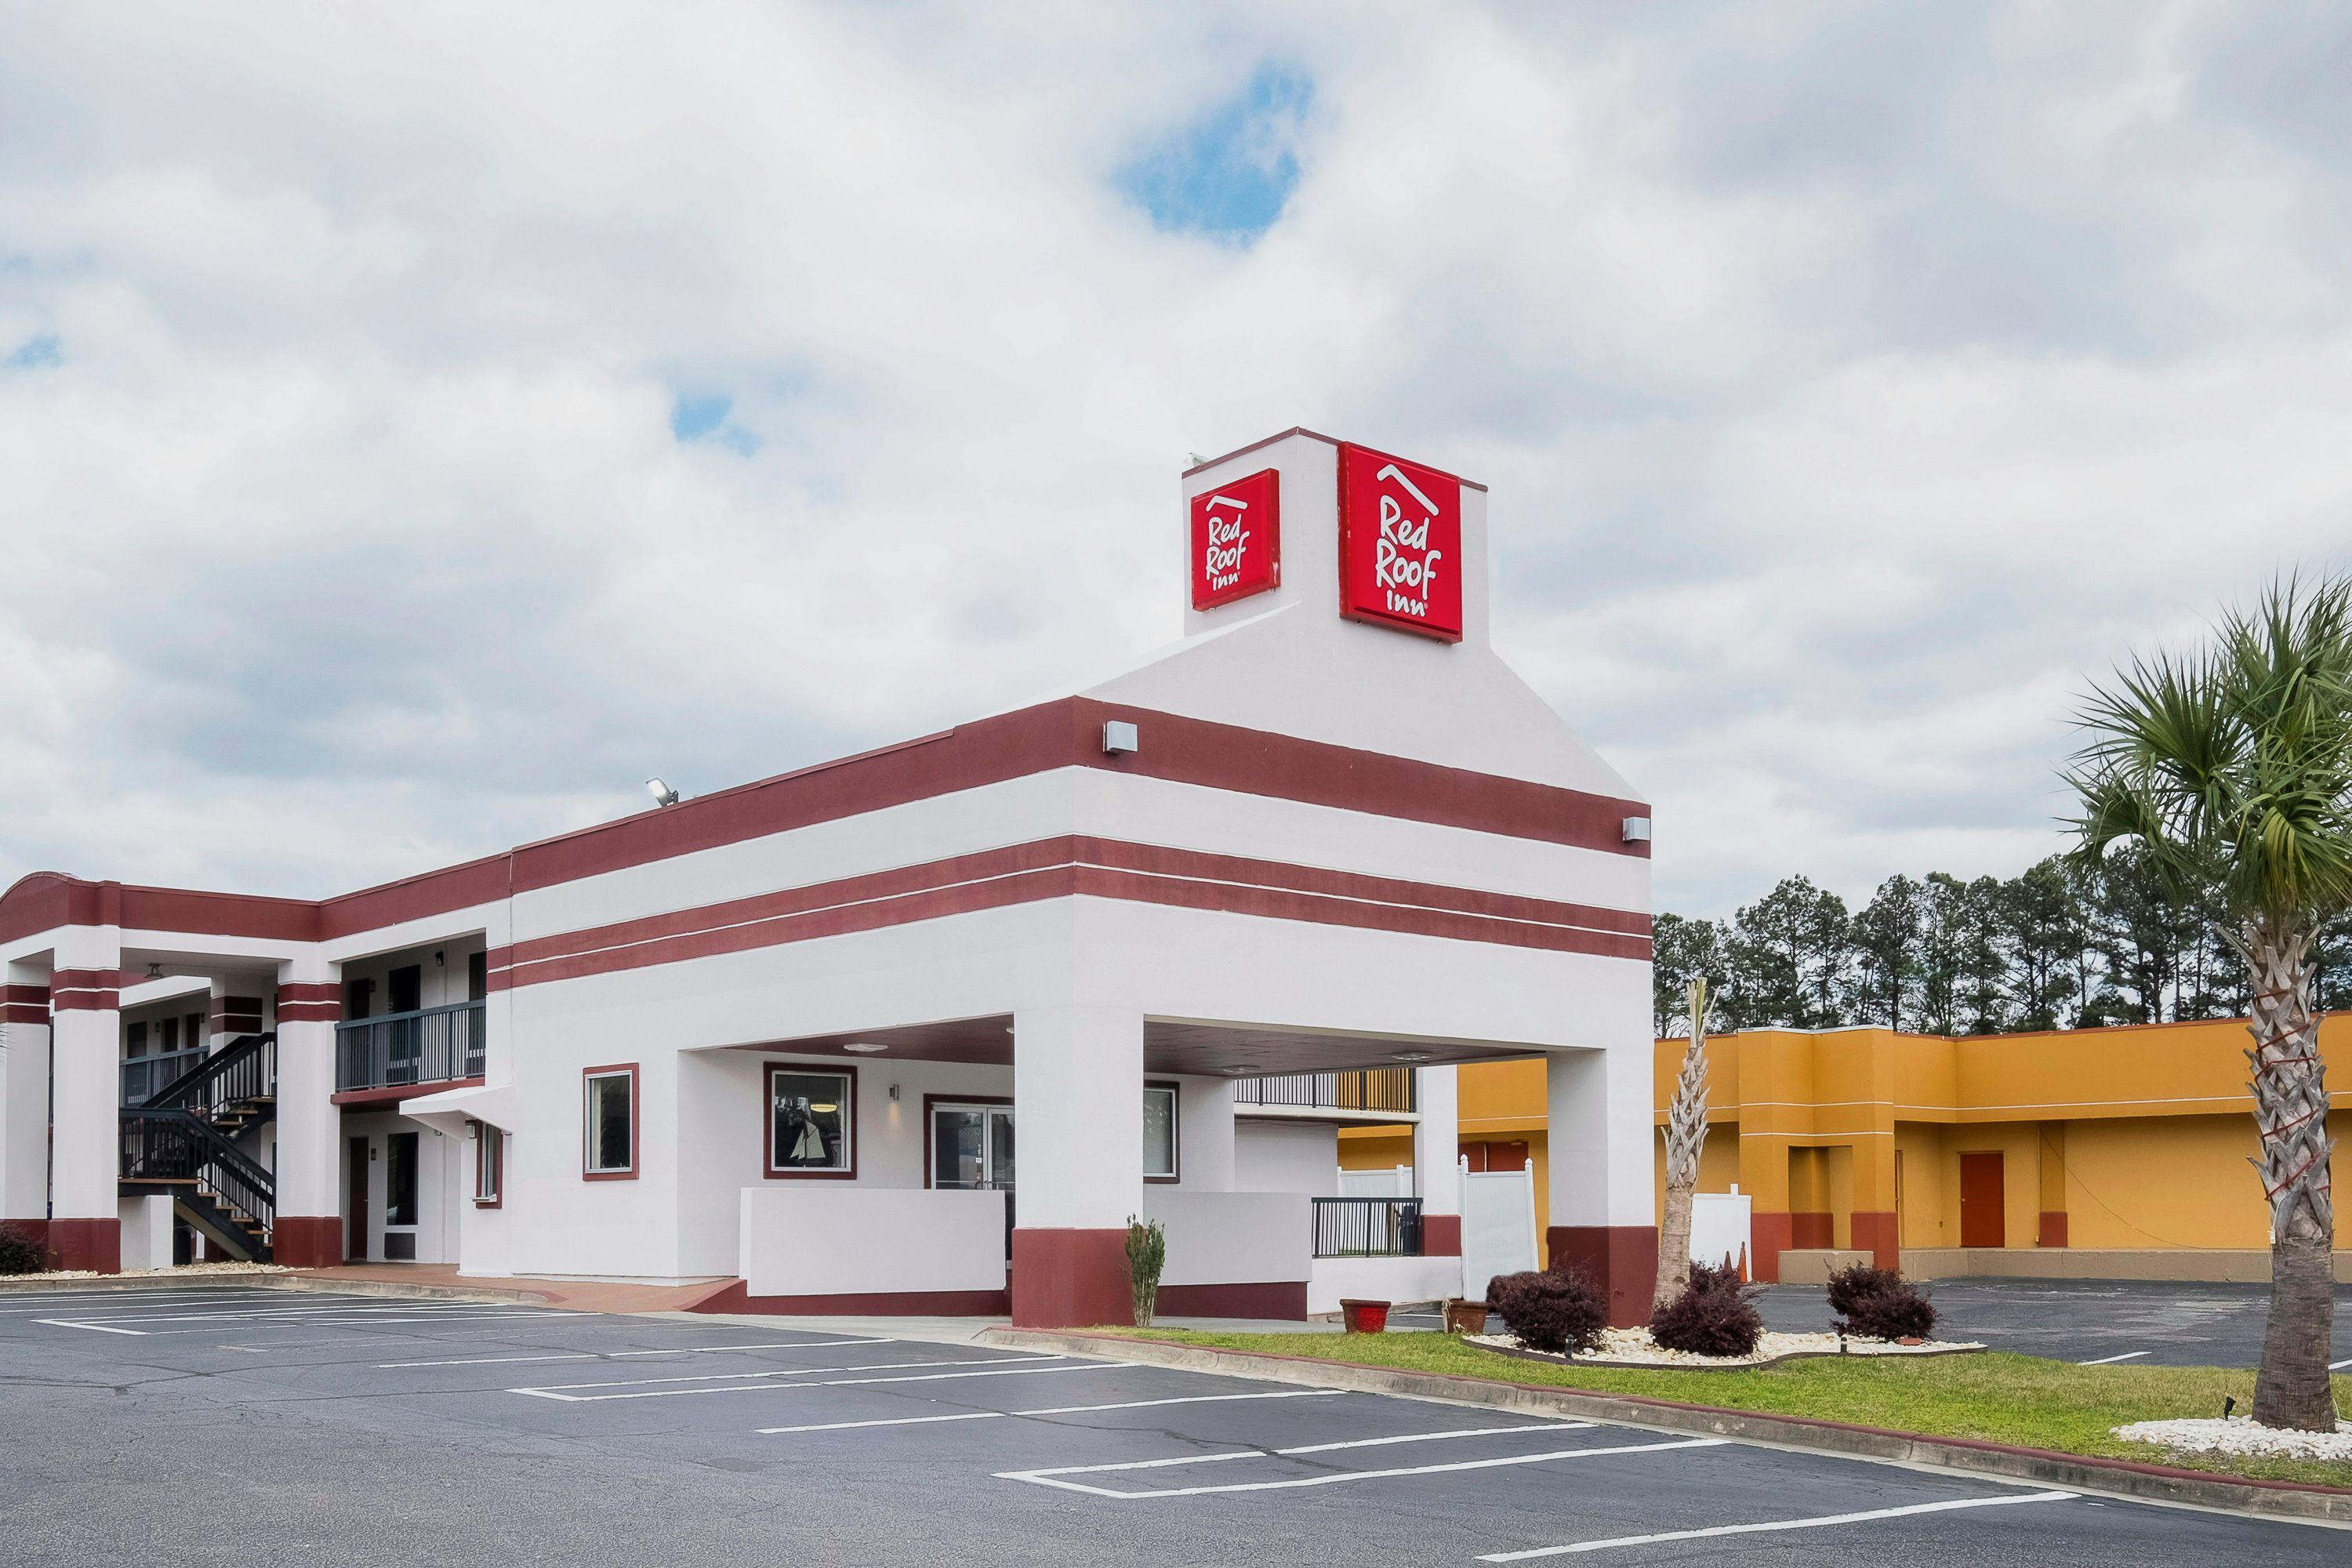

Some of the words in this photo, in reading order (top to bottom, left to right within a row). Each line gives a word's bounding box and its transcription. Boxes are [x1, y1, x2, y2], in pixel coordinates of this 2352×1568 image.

[1208, 513, 1241, 546] Red
[1380, 495, 1430, 550] Red
[1205, 531, 1250, 580] Roof
[1375, 538, 1442, 600] Roof
